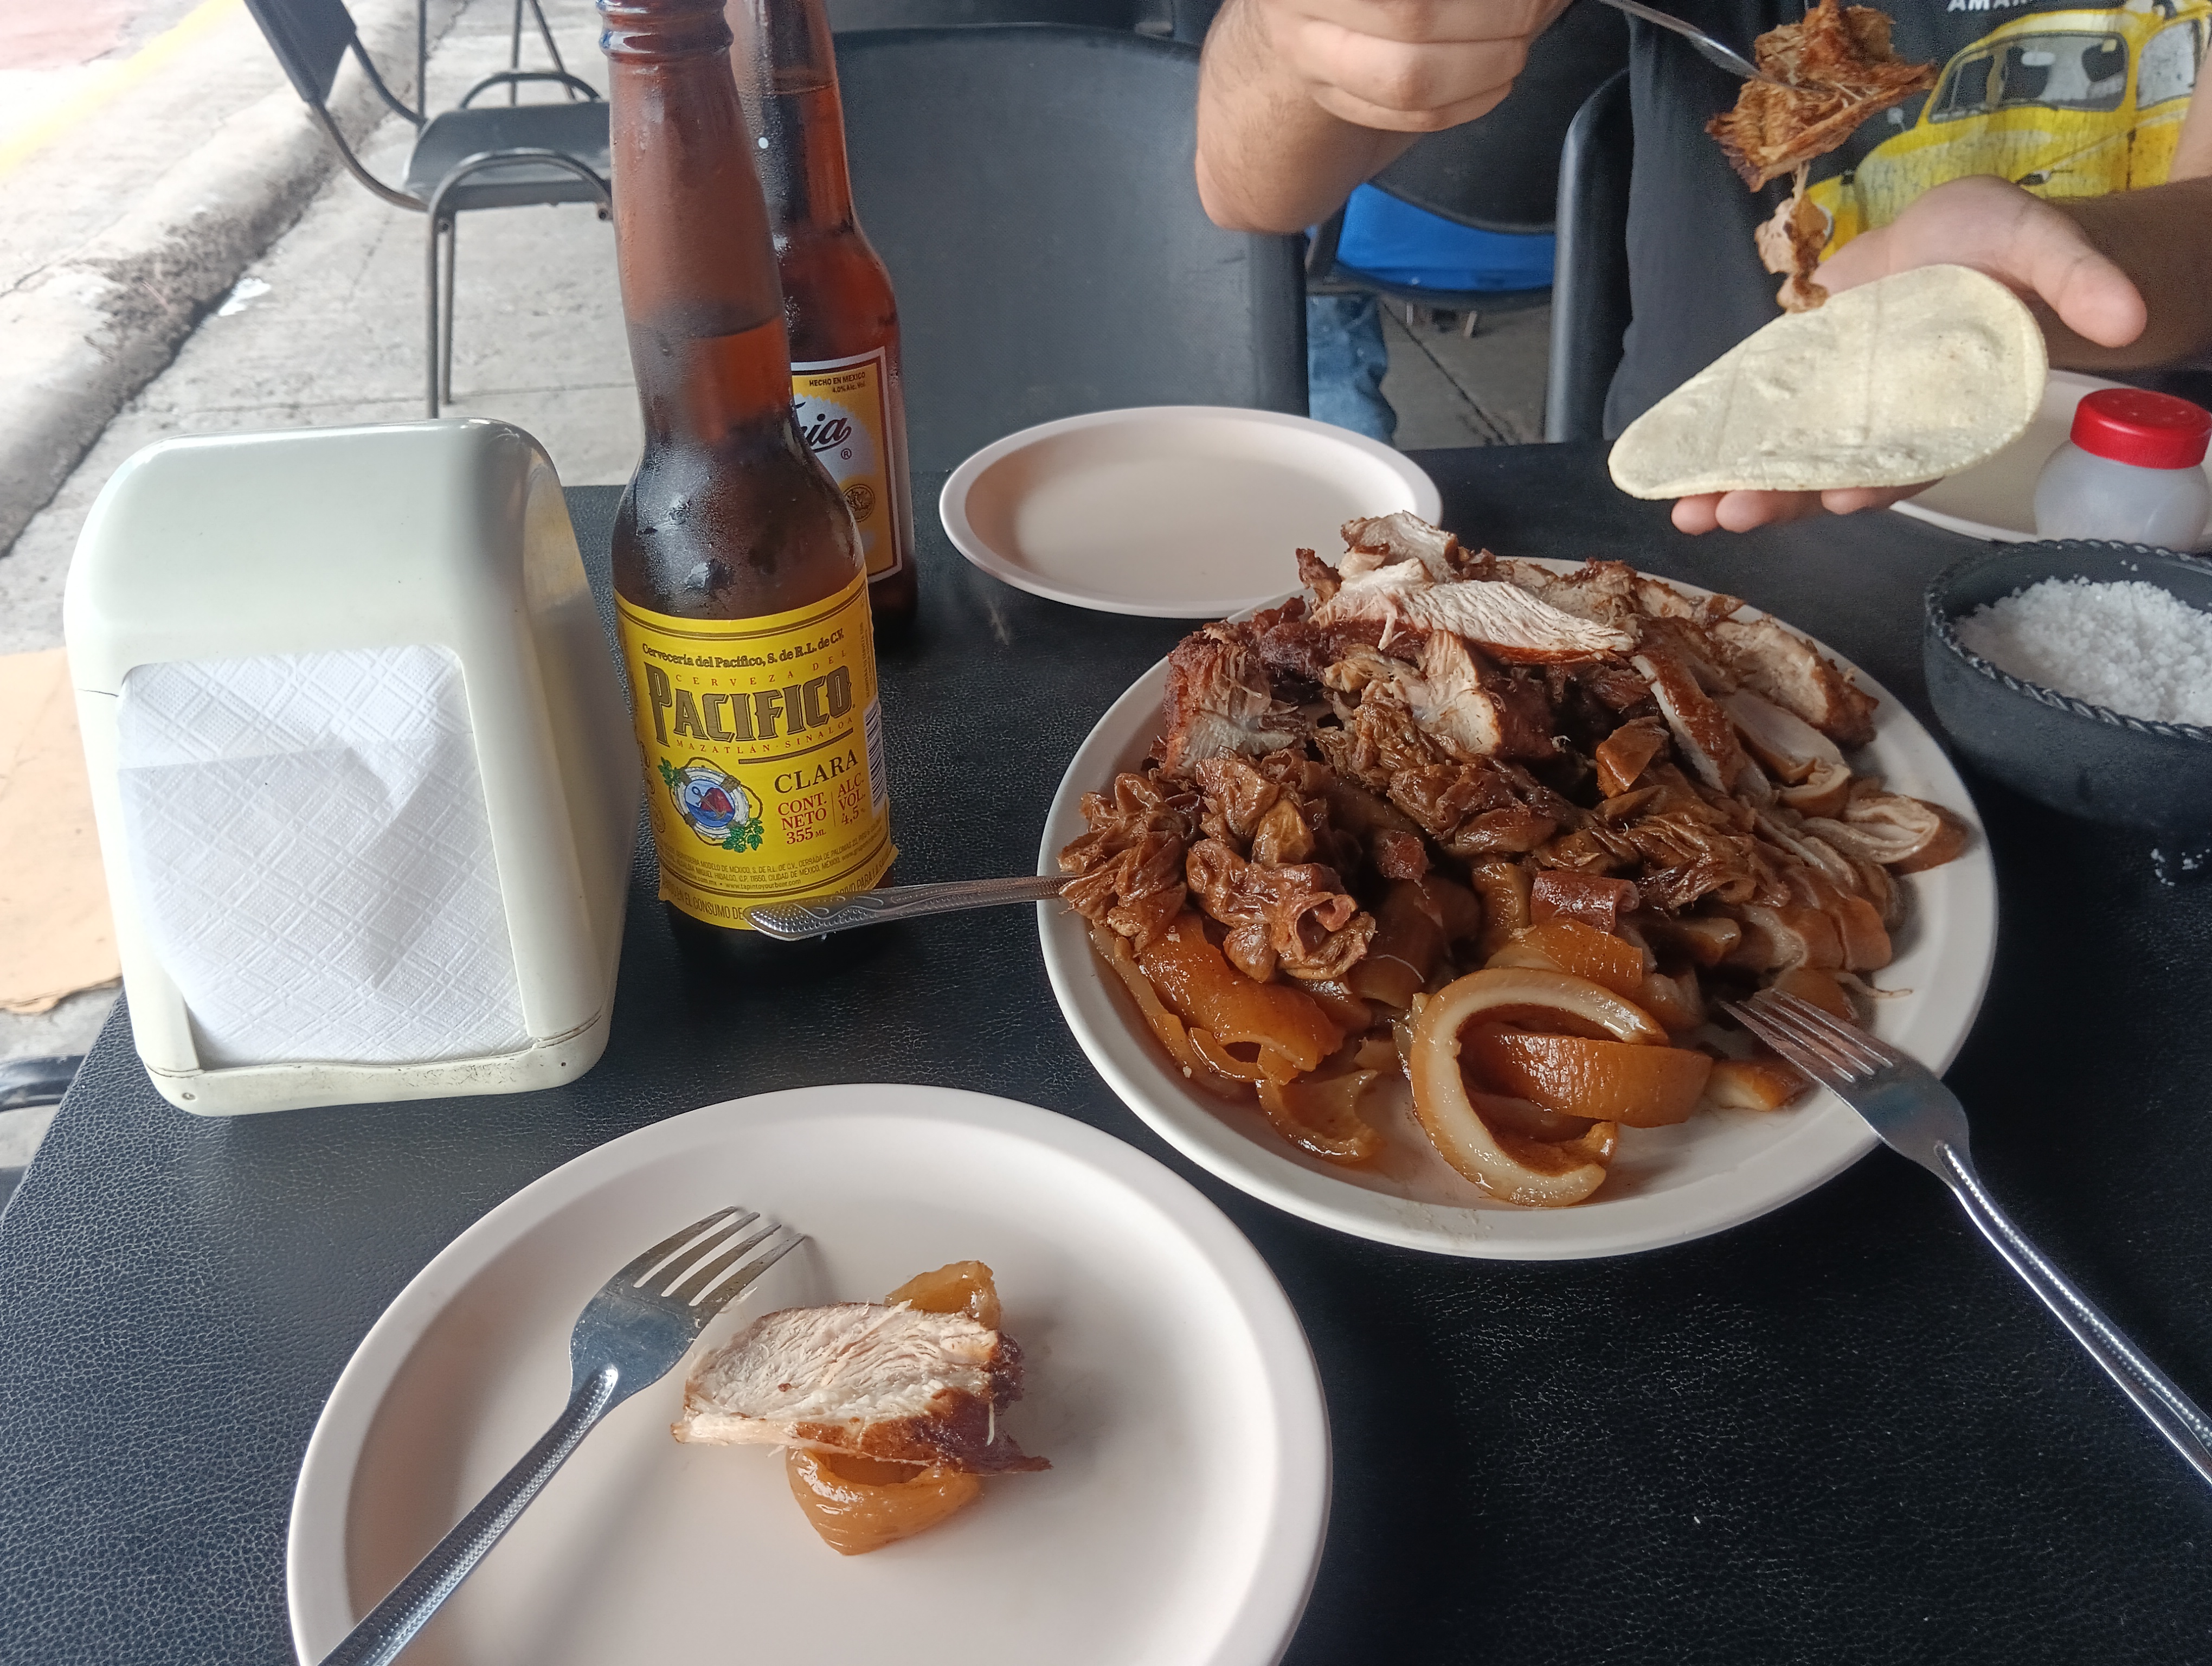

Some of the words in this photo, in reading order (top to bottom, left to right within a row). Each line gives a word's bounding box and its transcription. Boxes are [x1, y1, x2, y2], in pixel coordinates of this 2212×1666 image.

[809, 378, 832, 386] HECHO
[833, 376, 841, 385] EN
[695, 655, 714, 668] del
[767, 652, 778, 664] S.
[779, 649, 794, 662] de
[794, 642, 817, 658] R.L.
[818, 637, 830, 650] de
[830, 628, 844, 644] C.V.
[676, 670, 794, 687] CERVEZA
[812, 650, 846, 671] DEL
[644, 661, 852, 748] PACIFICO
[676, 739, 774, 754] MAZATLÁN
[785, 717, 853, 748] SINALOA
[774, 748, 859, 793] CLARA
[838, 772, 864, 798] ALC.
[777, 792, 827, 816] CONT.
[838, 789, 866, 811] VOL.
[781, 808, 827, 830] NETO
[786, 826, 813, 844] 355
[823, 851, 830, 860] DE
[685, 892, 693, 907] EL
[693, 896, 731, 919] CONSUMO
[732, 906, 744, 920] DE
